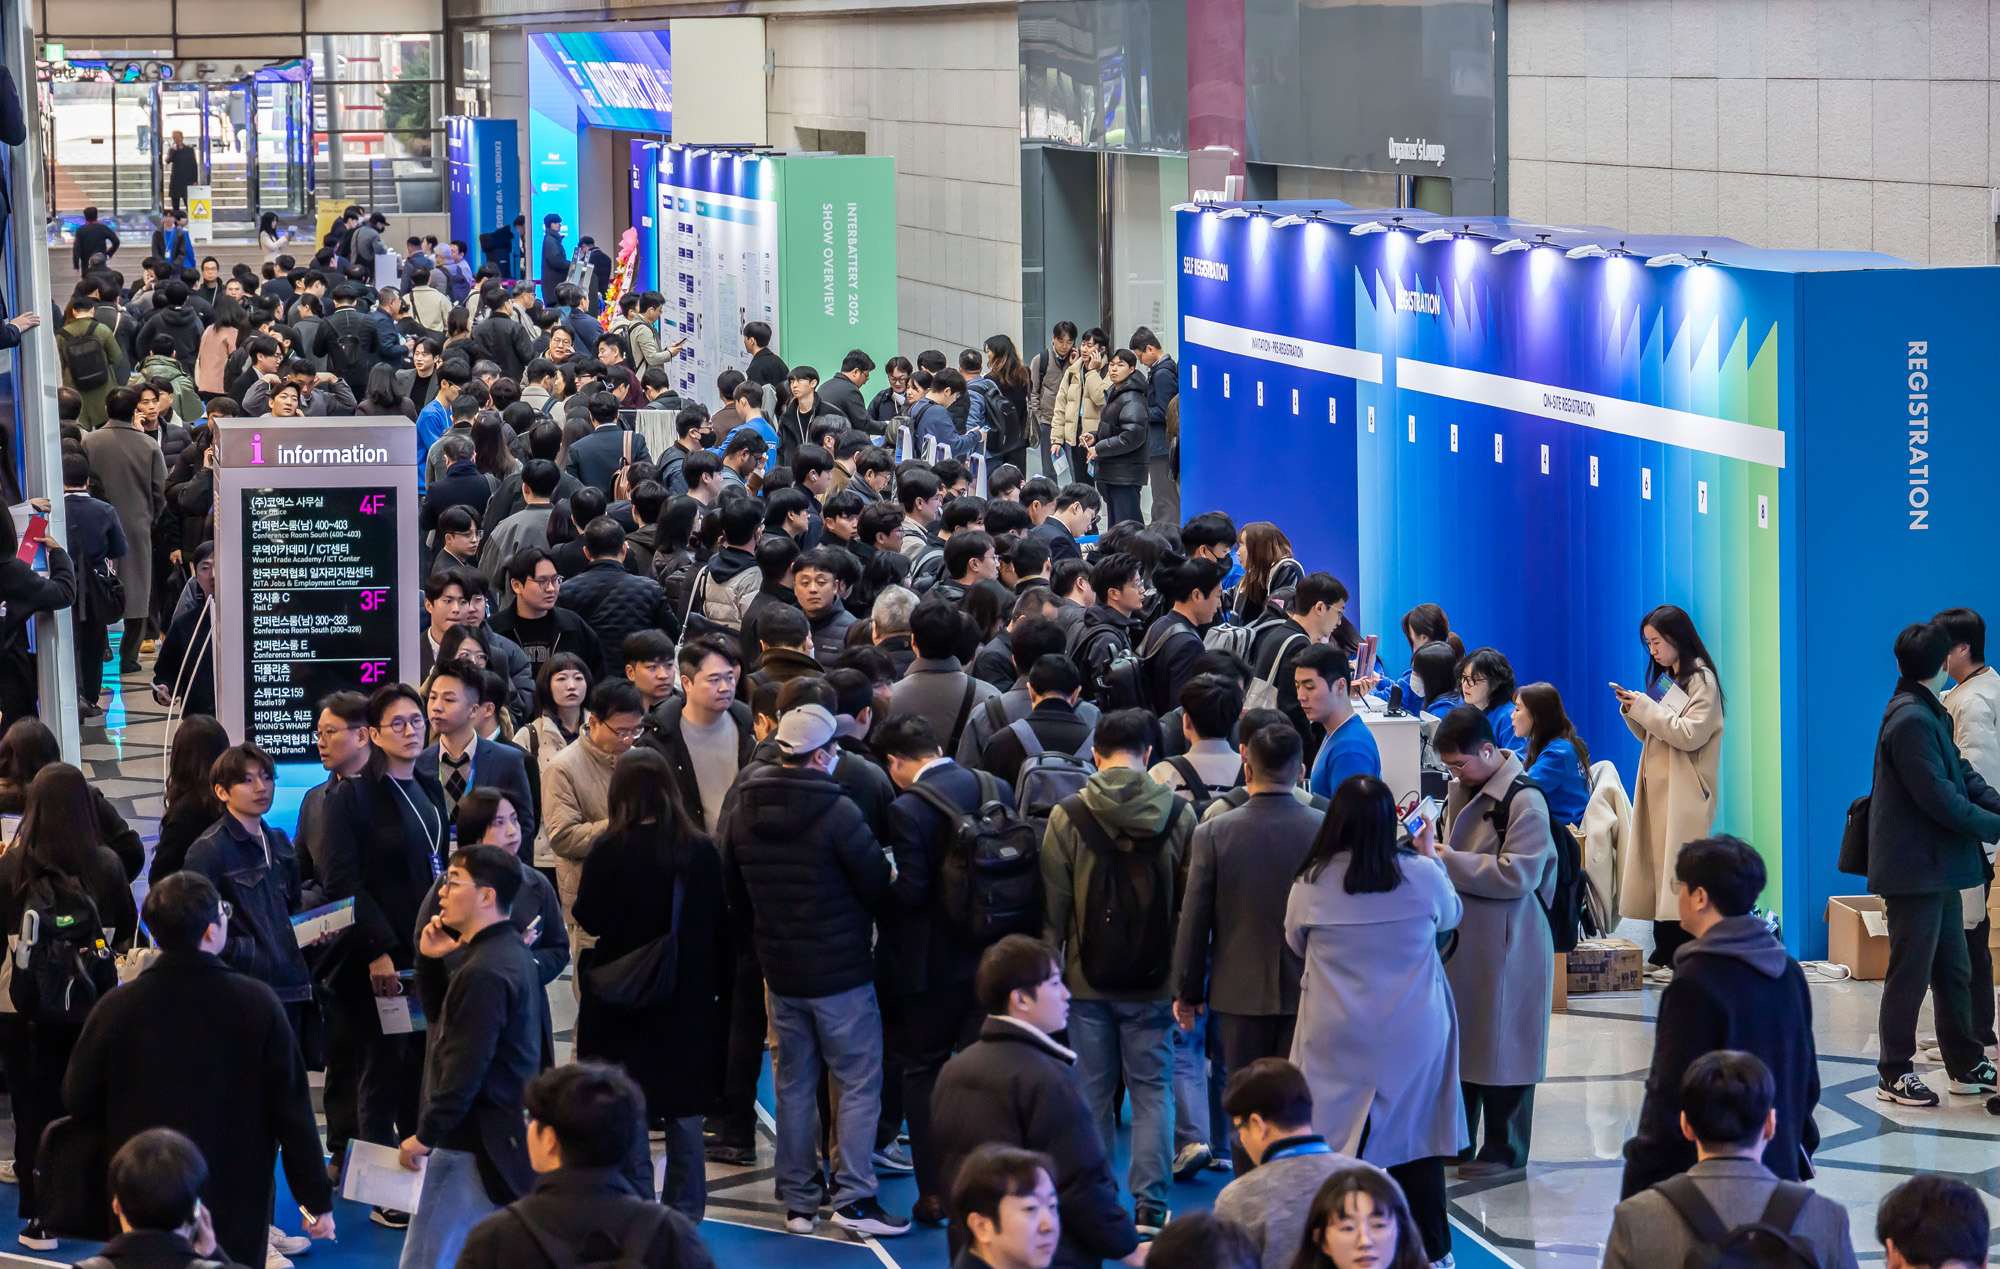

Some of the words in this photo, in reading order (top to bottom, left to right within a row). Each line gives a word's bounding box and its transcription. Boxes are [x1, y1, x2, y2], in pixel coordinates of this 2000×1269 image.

[1388, 137, 1422, 164] Organizer's
[1422, 138, 1445, 167] Lounge
[496, 204, 504, 228] REGIS
[822, 203, 833, 245] SHOW
[847, 202, 858, 290] INTERBATTERY
[1183, 256, 1194, 274] SELF
[1194, 258, 1228, 282] REGISTRATION
[823, 248, 834, 317] OVERVIEW
[848, 293, 859, 325] 2026
[1543, 393, 1561, 410] ON-SITE
[1562, 396, 1595, 418] REGISTRATION
[1908, 341, 1929, 530] REGISTRATION
[278, 444, 388, 464] information
[252, 496, 294, 508] (주)코엑스
[296, 496, 323, 507] 사무실
[360, 495, 386, 515] 4F
[252, 519, 313, 531] 컨퍼런스룸(남)
[315, 520, 348, 530] 400~403
[252, 544, 307, 555] 무역아카데미
[309, 544, 314, 554] /
[316, 544, 349, 554] ICT센터
[253, 567, 307, 579] 한국무역협회
[310, 566, 374, 578] 일자리지원센터
[253, 592, 280, 603] 전시홀
[282, 592, 290, 603] C
[360, 590, 386, 610] 3F
[254, 614, 313, 627] 컨퍼런스룸(남)
[315, 615, 348, 625] 300~328
[254, 640, 299, 651] 컨퍼런스룸
[300, 640, 308, 649] E
[254, 663, 290, 675] 더플라츠
[360, 662, 386, 682] 2F
[254, 688, 304, 698] 스튜디오159
[254, 711, 291, 722] 바이킹스
[294, 710, 312, 721] 워프
[254, 733, 310, 747] 한국무역협회
